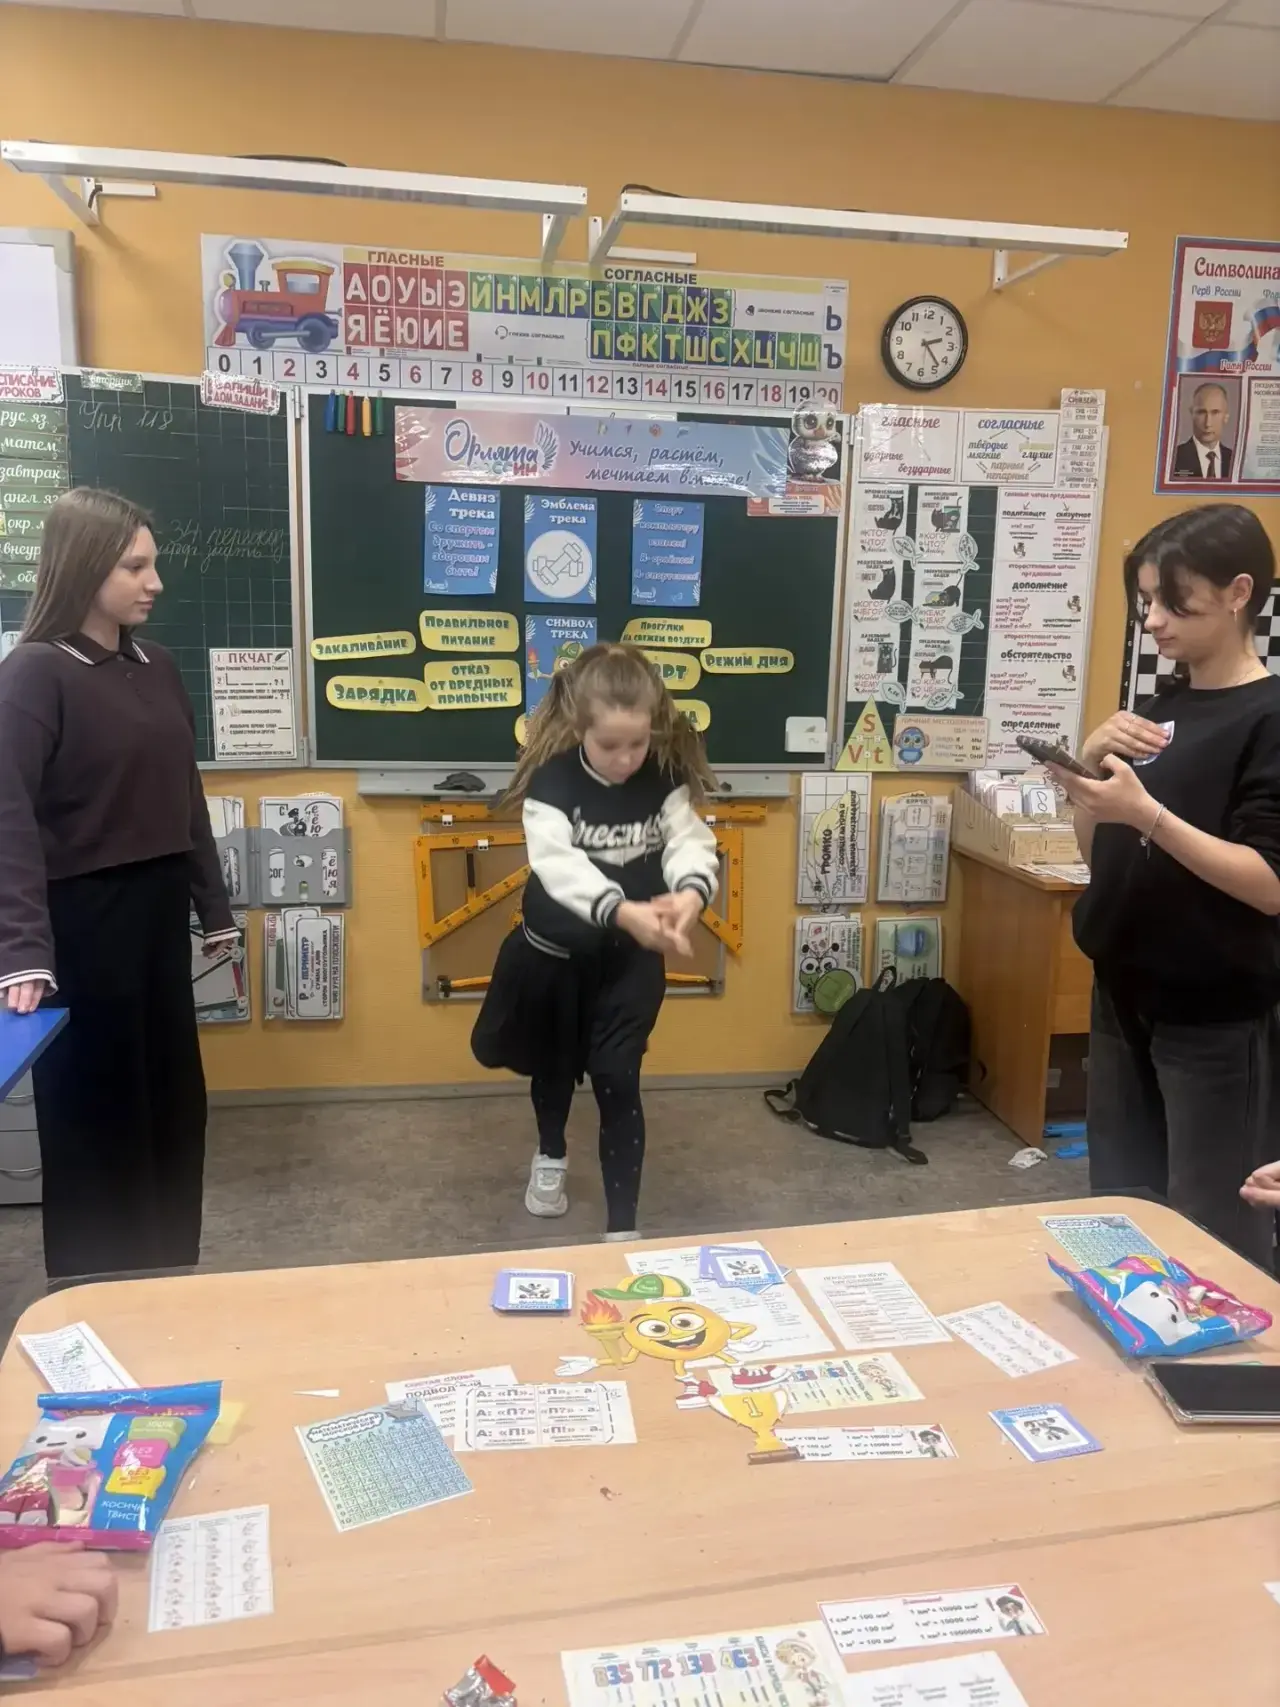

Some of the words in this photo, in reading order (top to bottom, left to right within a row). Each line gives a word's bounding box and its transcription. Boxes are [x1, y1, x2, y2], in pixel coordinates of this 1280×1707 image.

[367, 251, 445, 268] ГЛАСНЫЕ
[1194, 257, 1280, 280] Символика
[604, 268, 698, 285] СОГЛАСНЫЕ
[1214, 286, 1242, 297] России
[1263, 289, 1280, 299] Фла
[825, 305, 842, 331] Ь
[911, 312, 920, 322] 11
[924, 309, 935, 320] 12
[940, 315, 944, 325] 1
[900, 321, 912, 331] 10
[945, 326, 953, 336] 2
[895, 336, 903, 345] 9
[946, 342, 954, 351] 3
[823, 343, 842, 369] Ъ
[897, 350, 905, 360] 8
[941, 356, 948, 365] 4
[905, 362, 913, 371] 7
[931, 365, 938, 374] 5
[1245, 361, 1272, 371] России
[218, 354, 231, 372] 0
[252, 357, 262, 374] 1
[283, 358, 296, 377] 2
[315, 360, 328, 378] 3
[346, 362, 360, 380] 4
[378, 364, 391, 382] 5
[409, 365, 422, 383] 6
[440, 367, 453, 384] 7
[471, 368, 484, 387] 8
[501, 370, 514, 388] 9
[526, 371, 549, 390] 10
[558, 374, 578, 392] 11
[586, 375, 609, 394] 12
[615, 376, 639, 395] 13
[645, 377, 668, 397] 14
[674, 379, 697, 398] 15
[703, 381, 725, 399] 16
[732, 382, 754, 401] 17
[760, 384, 782, 402] 18
[789, 386, 811, 401] 19
[917, 368, 925, 377] 6
[881, 415, 941, 429] гласные
[977, 417, 1045, 430] согласные
[445, 419, 539, 467] Орлята
[968, 440, 1009, 452] твёрдые
[569, 440, 638, 464] Учимся,
[648, 445, 724, 468] растём,
[966, 451, 1001, 461] мягкие
[1021, 450, 1054, 462] глухие
[897, 462, 953, 476] безударные
[990, 461, 1025, 472] парные
[0, 465, 61, 484] завтрак
[584, 467, 670, 485] мечтаем
[985, 471, 1030, 482] непарные
[447, 488, 496, 504] Девиз
[540, 498, 596, 511] Эмблема
[448, 508, 495, 520] трека
[549, 512, 586, 525] трека
[1012, 581, 1068, 590] дополнение
[545, 618, 594, 629] СИМВОЛ
[550, 629, 589, 639] ТРЕКА
[228, 652, 273, 663] ПКЧАГ
[1000, 648, 1073, 660] обстоятельство
[756, 654, 789, 669] ДНЯ
[451, 664, 490, 676] ОТКАЗ
[429, 680, 445, 691] ОТ
[447, 677, 514, 692] ВРЕДНЫХ
[437, 692, 509, 705] ПРИВЫЧЕК
[862, 713, 876, 732] S
[1001, 719, 1061, 730] определение
[848, 744, 863, 763] V
[821, 829, 832, 875] ГРОМКО
[743, 1396, 763, 1418] 1
[101, 1500, 150, 1514] КОСИЧА
[107, 1510, 139, 1521] ТВИСТ
[720, 1646, 760, 1670] 463
